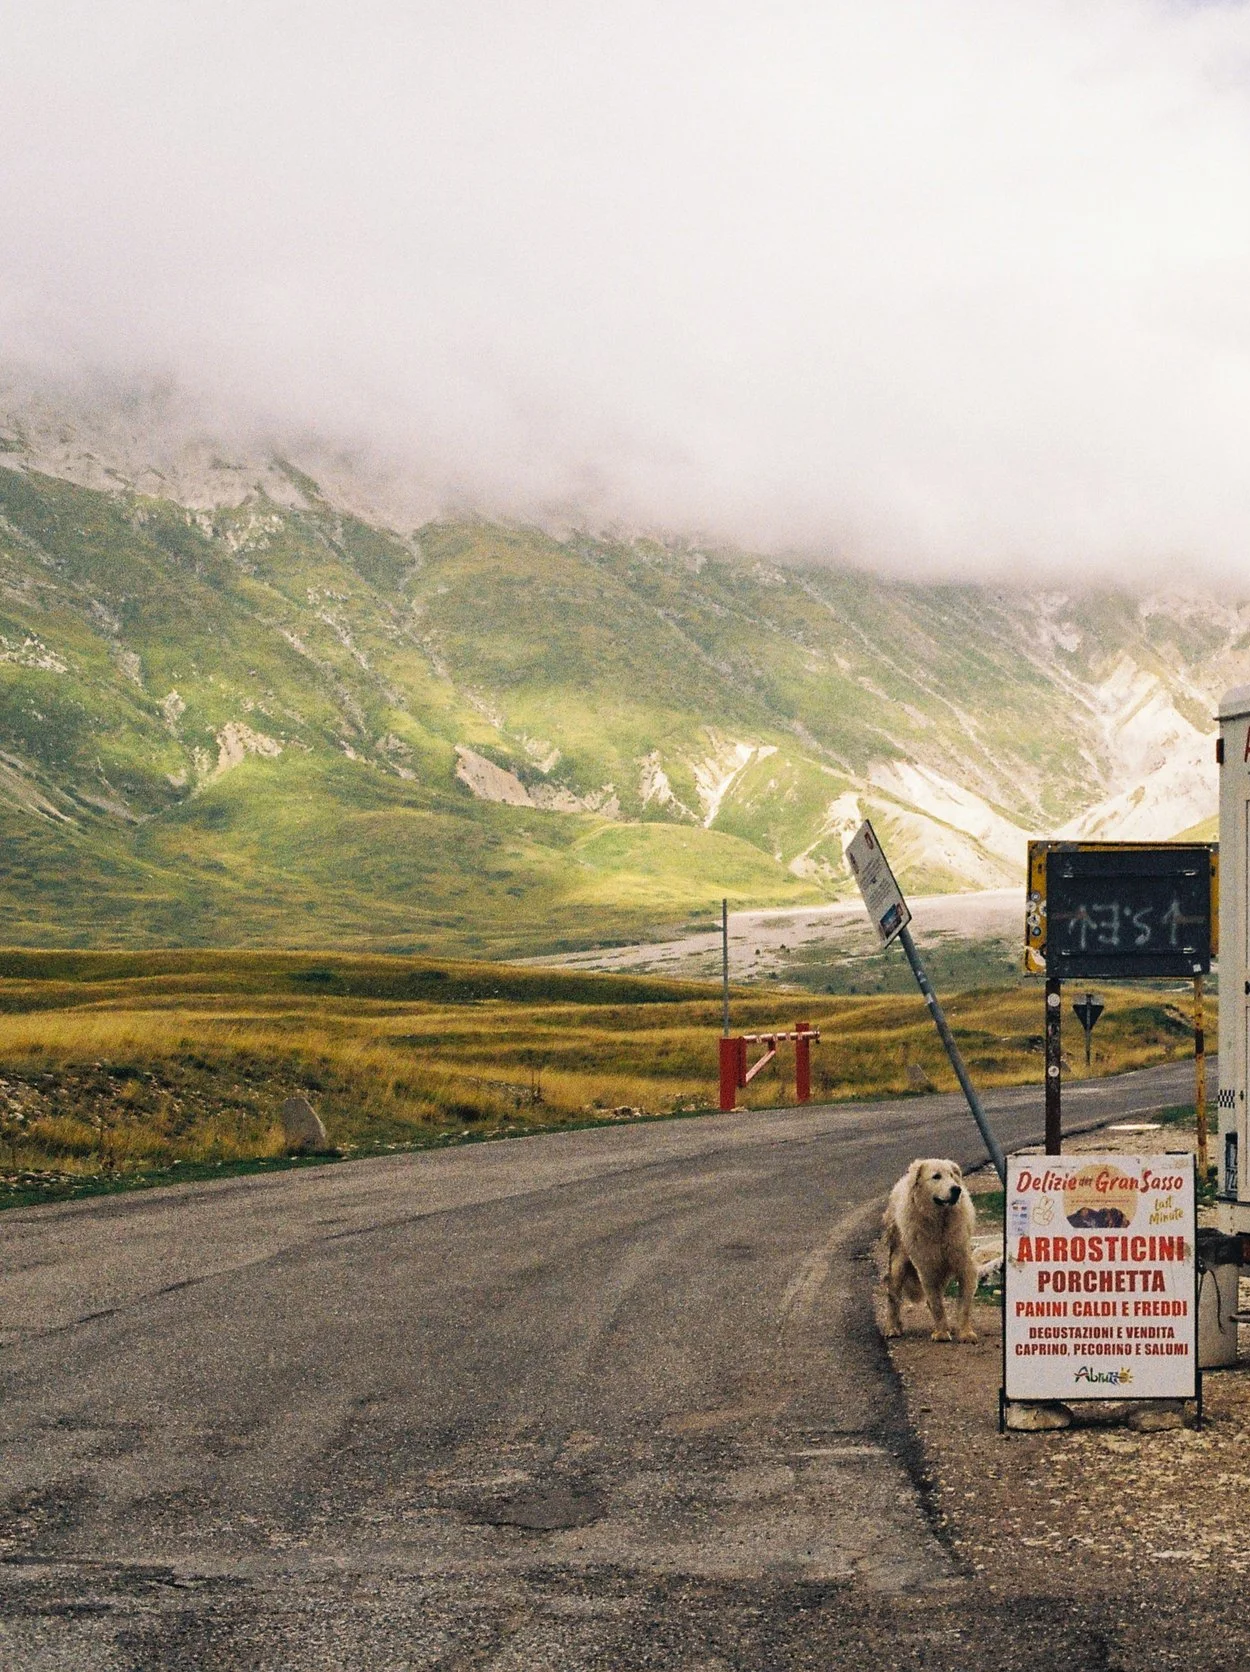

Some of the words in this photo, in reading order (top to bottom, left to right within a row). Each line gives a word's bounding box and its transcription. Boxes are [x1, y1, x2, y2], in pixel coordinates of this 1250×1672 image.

[1016, 1170, 1077, 1193] Delizie
[1154, 1195, 1173, 1212] Last
[1149, 1207, 1184, 1225] Minute
[1017, 1235, 1185, 1262] ARROSTICINI
[1037, 1270, 1166, 1293] PORCHETTA
[1015, 1301, 1068, 1317] PANINI
[1072, 1301, 1117, 1317] CALDI
[1121, 1301, 1129, 1316] E
[1133, 1300, 1188, 1317] FREDDI
[1029, 1327, 1114, 1339] DEGUSTAZIONI
[1117, 1327, 1123, 1339] E
[1125, 1326, 1175, 1339] VENDITA
[1015, 1343, 1071, 1357] CAPRINO,
[1074, 1343, 1132, 1356] PECORINO
[1135, 1343, 1142, 1356] E
[1144, 1343, 1189, 1356] SALUMI
